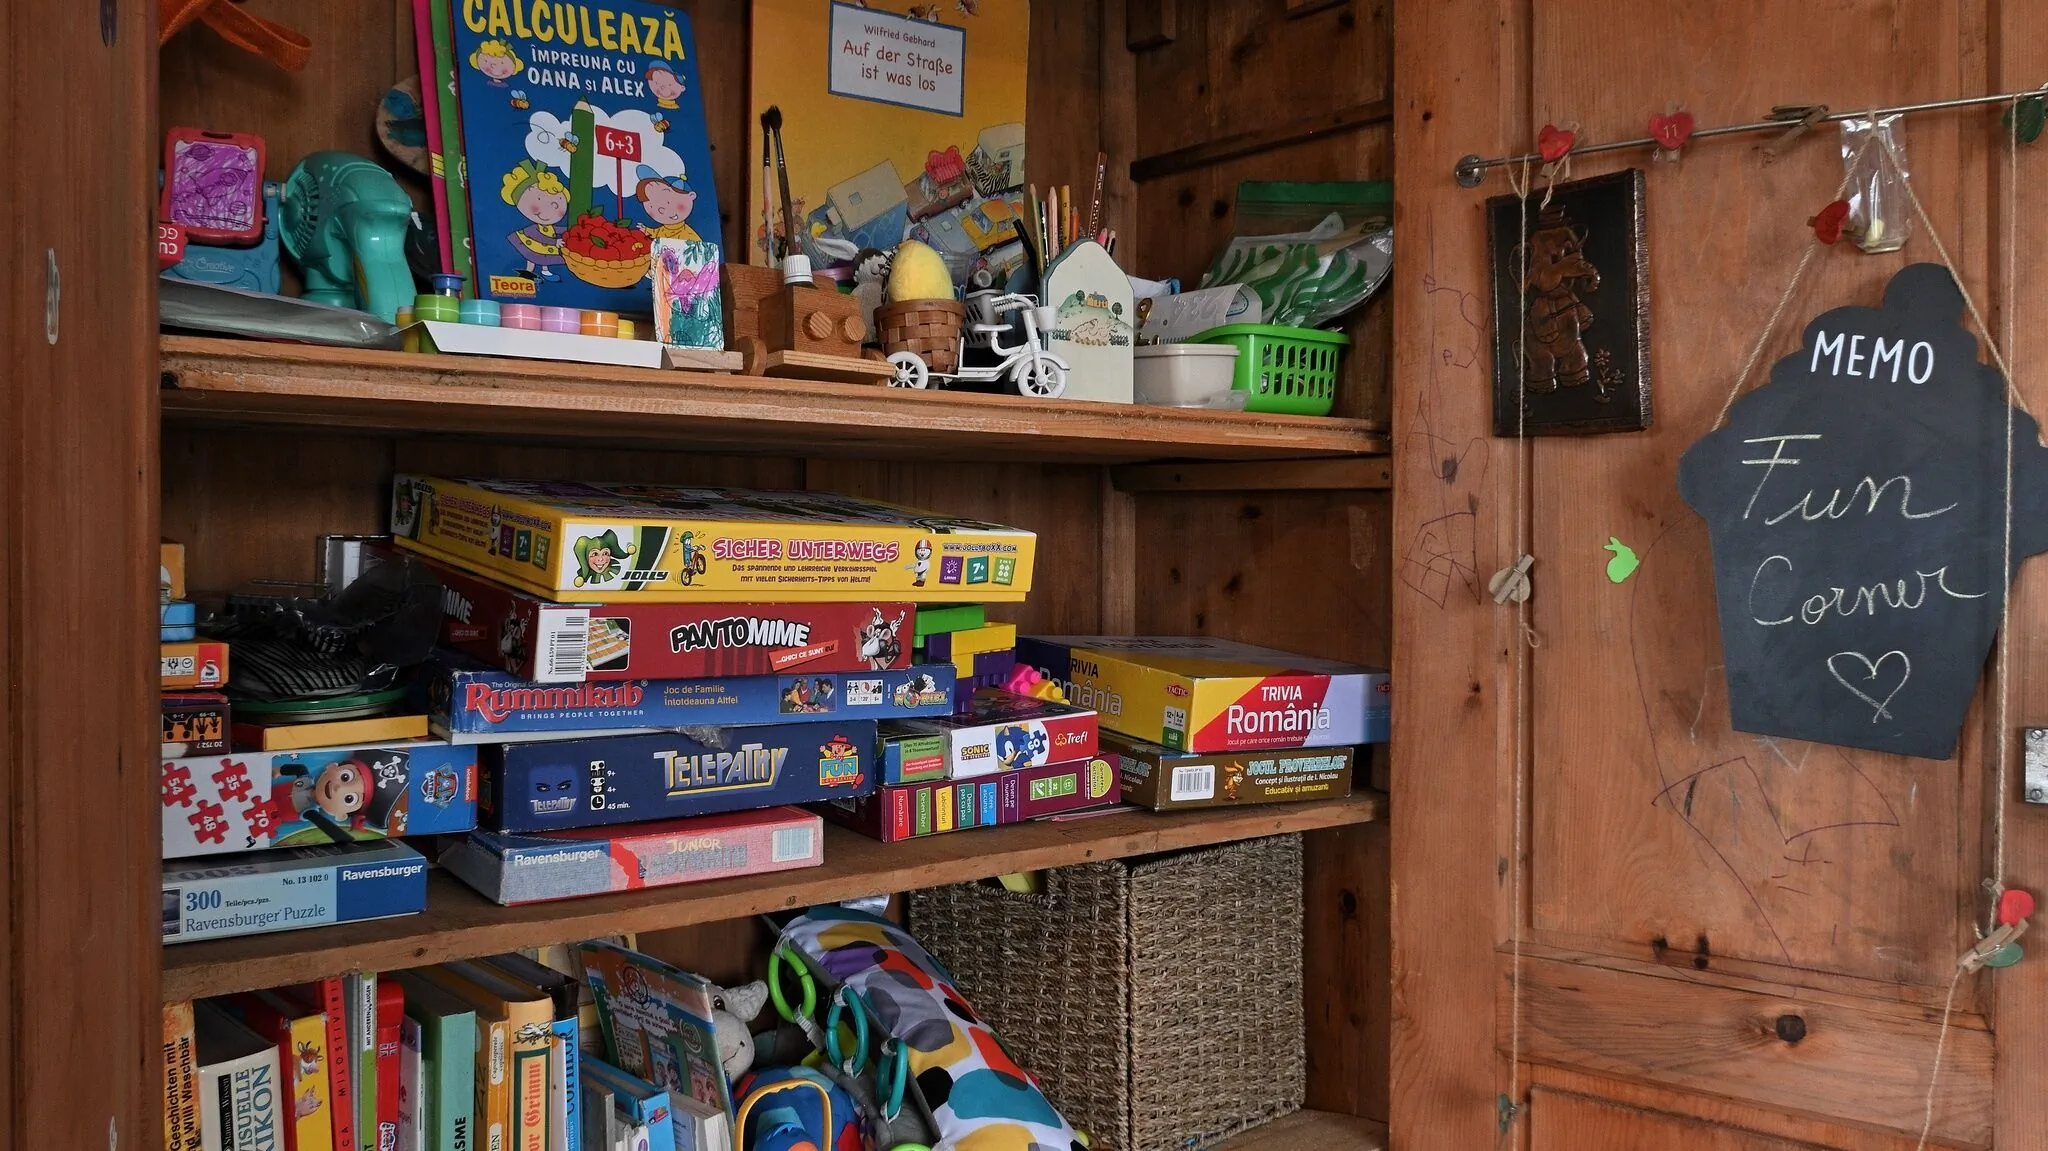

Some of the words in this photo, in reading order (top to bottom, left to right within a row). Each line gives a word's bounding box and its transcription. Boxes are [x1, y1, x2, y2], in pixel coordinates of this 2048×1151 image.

[463, 0, 686, 61] CALCULEAZĂ
[864, 24, 900, 39] Wilfried
[903, 34, 936, 48] Gebhard
[617, 59, 636, 75] CU
[843, 40, 871, 57] Auf
[876, 46, 901, 63] der
[907, 52, 953, 76] Straße
[528, 67, 581, 90] OANA
[602, 77, 644, 98] ALEX
[861, 63, 880, 80] ist
[886, 71, 912, 87] was
[918, 74, 936, 92] los
[1663, 123, 1678, 139] 11
[605, 131, 635, 155] 6+3
[491, 278, 535, 292] Teora
[1810, 330, 1935, 384] MEMO
[1742, 434, 1959, 526] Fun
[712, 537, 783, 560] SICHER
[788, 539, 900, 562] UNTERWEGS
[621, 570, 670, 581] JOLLY
[1750, 555, 1990, 626] Corner
[670, 617, 811, 653] PANTOMIME
[504, 681, 527, 689] Original
[664, 686, 680, 694] Joc
[682, 685, 693, 694] de
[695, 685, 725, 693] Familie
[1261, 685, 1303, 702] TRIVIA
[465, 680, 645, 725] Rummikub
[716, 695, 738, 705] Altfel
[560, 711, 594, 719] PEOPLE
[1227, 702, 1332, 735] România
[1028, 740, 1040, 750] 60
[1067, 731, 1088, 746] Trefl
[1227, 738, 1239, 746] Jocul
[1239, 738, 1246, 746] pe
[961, 744, 989, 757] SONIC
[653, 743, 788, 793] TELEPATHY
[821, 761, 857, 778] FUN
[1247, 760, 1277, 776] JOCUL
[170, 777, 183, 795] 54
[227, 774, 239, 792] 35
[1255, 777, 1278, 785] Concept
[1319, 772, 1338, 780] Nicolau
[1265, 786, 1293, 795] Educativ
[1301, 783, 1329, 792] amuzant
[530, 797, 577, 812] TELEPATHY
[617, 801, 631, 809] min.
[961, 800, 966, 809] cu
[1009, 798, 1016, 808] pe
[204, 815, 216, 832] 48
[254, 810, 269, 828] 70
[666, 838, 722, 855] JUNIOR
[514, 848, 601, 868] Ravensburger
[282, 877, 296, 886] No.
[298, 876, 307, 884] 13
[309, 874, 323, 883] 102
[342, 864, 423, 882] Ravensburger
[185, 890, 222, 911] 300
[186, 910, 280, 933] Ravensburger
[283, 904, 326, 921] Puzzle
[164, 1041, 177, 1067] mit
[179, 1037, 192, 1102] Waschbär
[524, 1063, 542, 1128] Grimm
[167, 1068, 182, 1151] Geschichten
[182, 1104, 194, 1135] Willi
